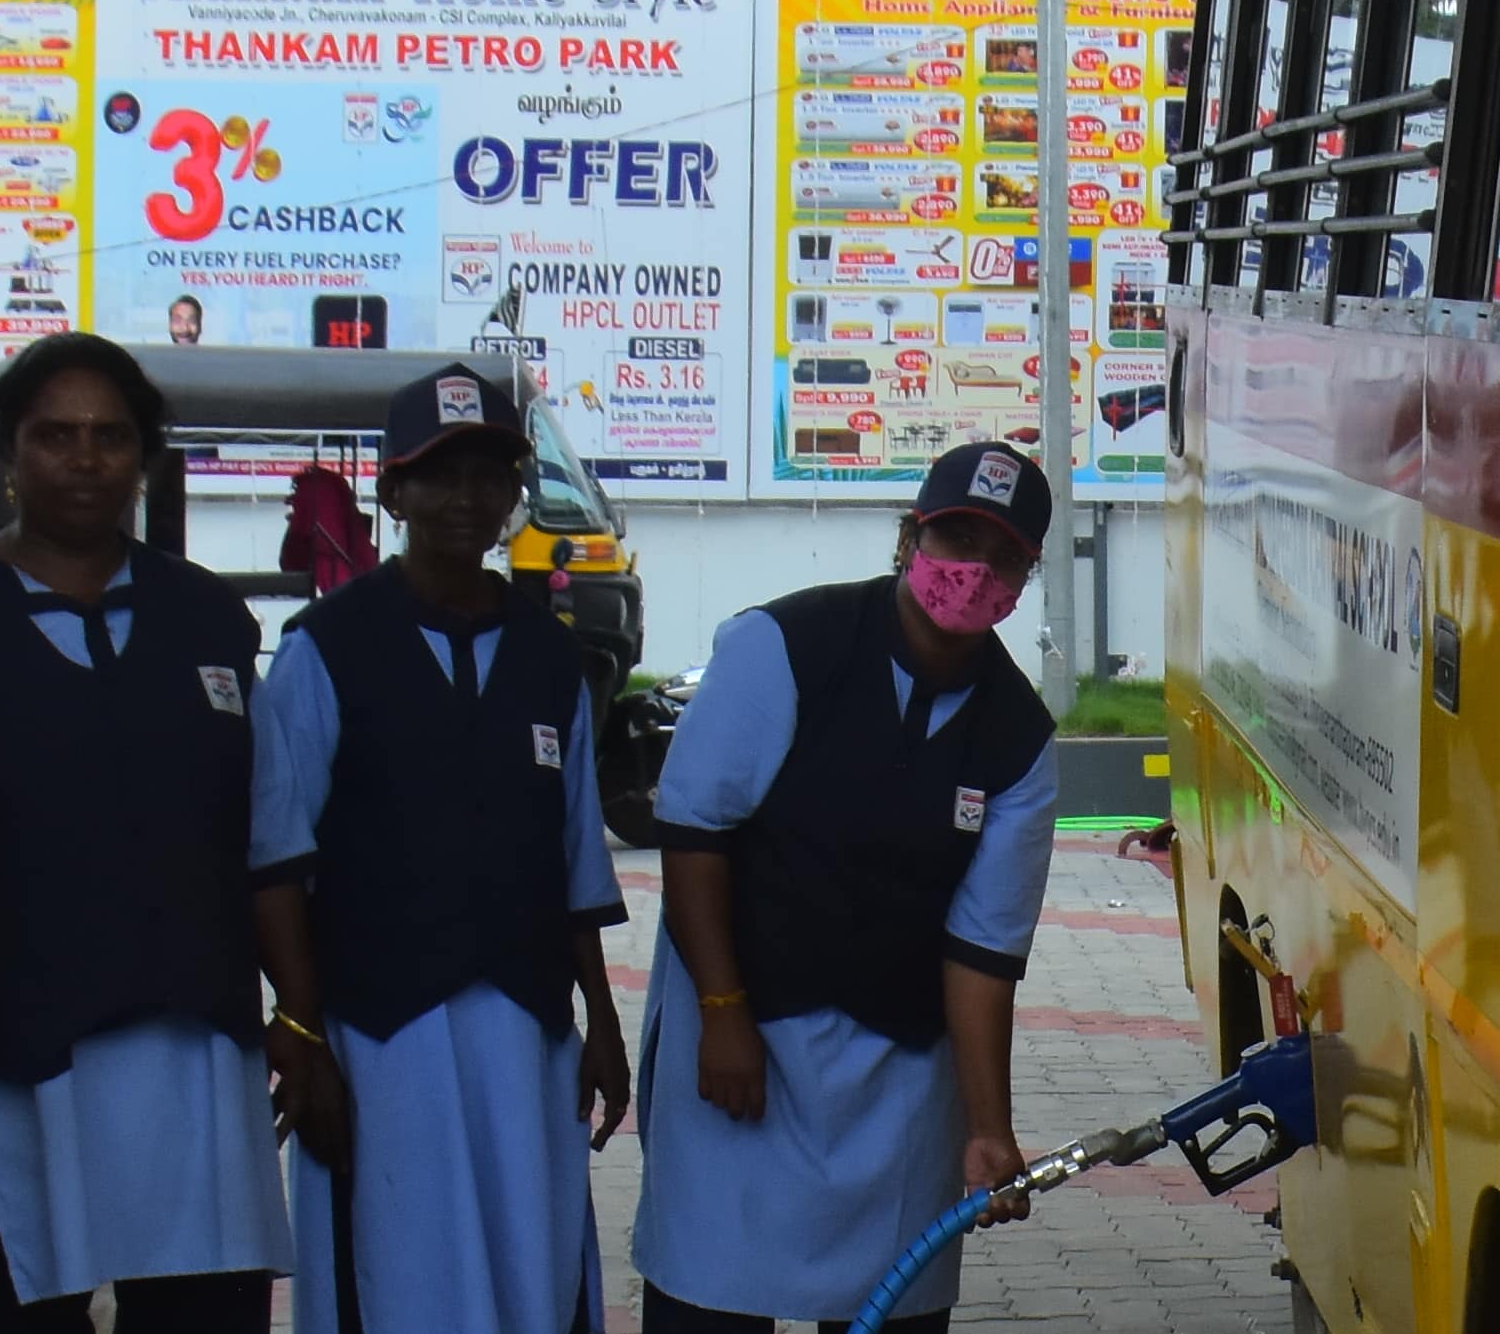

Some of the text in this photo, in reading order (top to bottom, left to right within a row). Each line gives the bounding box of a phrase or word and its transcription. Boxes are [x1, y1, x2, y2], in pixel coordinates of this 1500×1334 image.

[864, 0, 932, 13] Home
[438, 10, 464, 24] CSI
[467, 10, 531, 28] Complex,
[153, 28, 681, 74] THANKAM PETRO PARK
[518, 83, 623, 125] வழங்கும்
[144, 107, 283, 243] 3%
[453, 135, 718, 208] OFFER
[227, 204, 405, 234] CASHBACK
[509, 229, 574, 255] Welcome
[578, 239, 594, 255] to
[146, 250, 402, 271] ON EVERY FUEL PURCHASE?
[461, 261, 485, 274] HP
[214, 272, 246, 286] YOU
[248, 273, 300, 287] HEARD
[301, 273, 316, 287] IT
[319, 274, 368, 288] RIGHT.
[508, 262, 722, 297] COMPANY OWNED
[562, 300, 722, 331] HPCL OUTLET
[328, 321, 372, 348] HP
[474, 339, 545, 359] PETROL
[634, 339, 700, 358] DIESEL
[616, 363, 705, 390] Rs. 3.16
[1103, 362, 1155, 371] CORNER
[1103, 373, 1157, 382] WOODEN
[451, 391, 470, 401] HP
[611, 410, 638, 423] Less
[642, 410, 673, 423] Than
[988, 466, 1008, 479] HP
